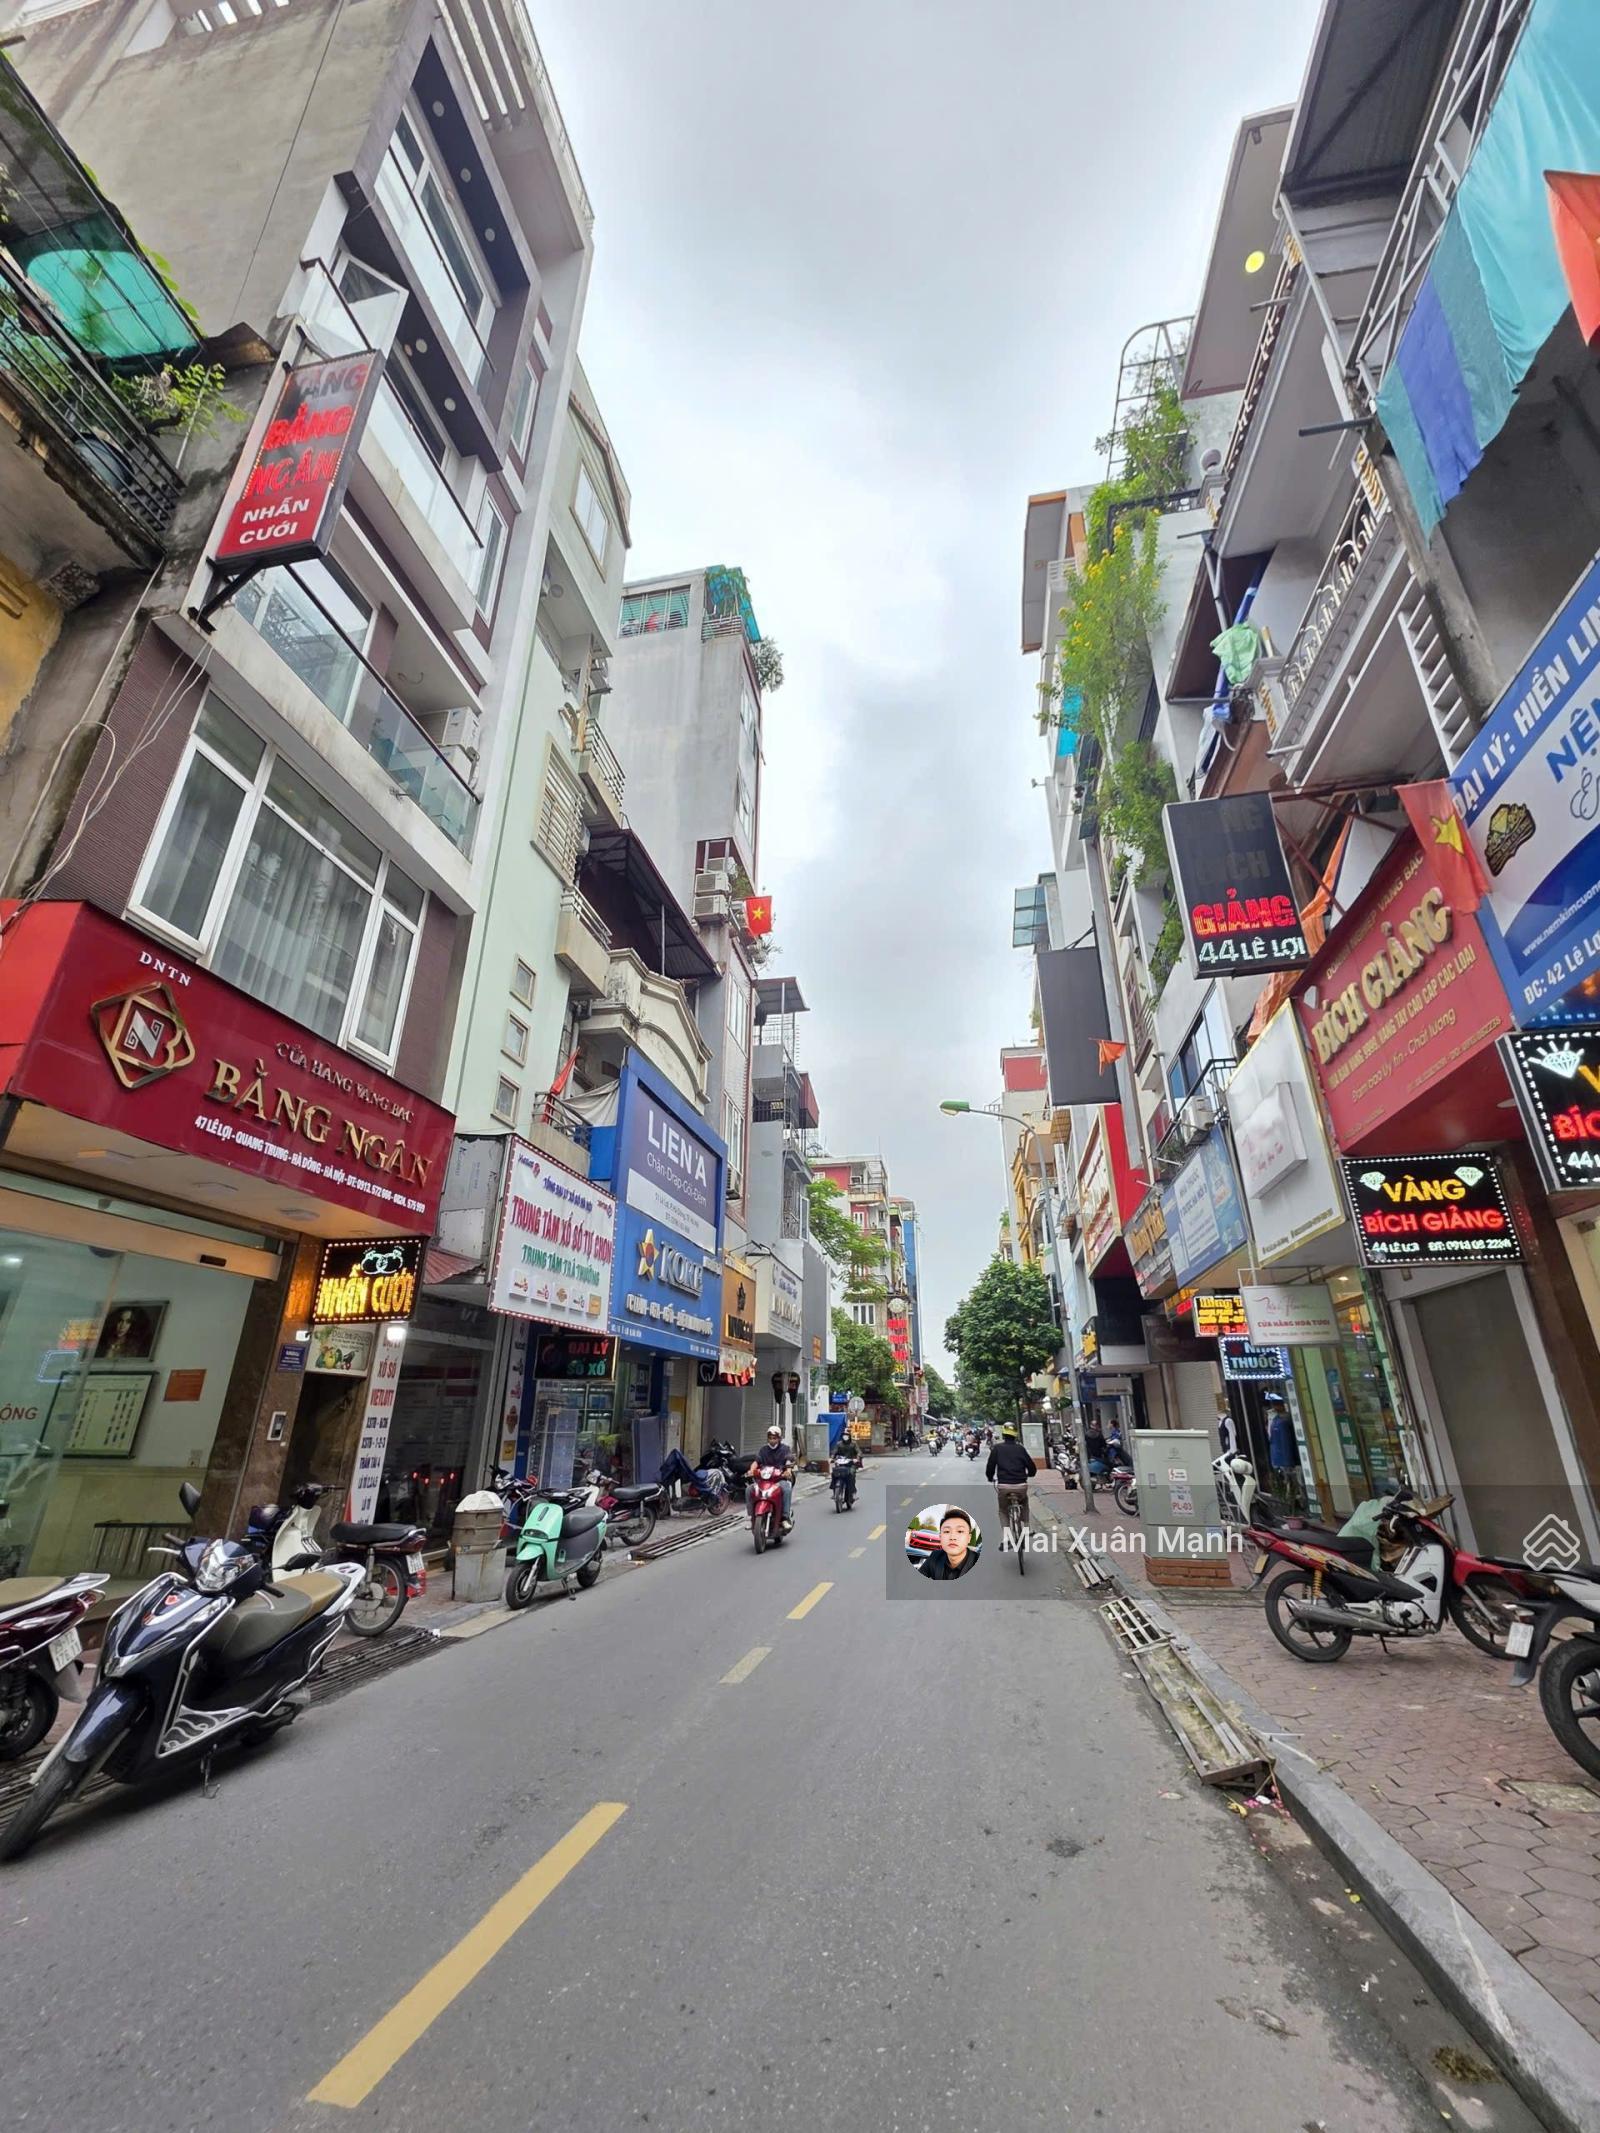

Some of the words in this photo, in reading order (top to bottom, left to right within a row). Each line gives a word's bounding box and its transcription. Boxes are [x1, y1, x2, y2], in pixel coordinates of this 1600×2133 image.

[239, 521, 298, 545] CƯỚI
[1482, 733, 1516, 781] LÝ:
[1513, 654, 1571, 738] HIỀN
[1192, 887, 1297, 938] GIẢNG
[1199, 939, 1239, 964] 44
[1271, 936, 1306, 961] LỢI
[1454, 943, 1477, 974] LOẠI
[139, 950, 192, 987] DNTN
[1311, 982, 1369, 1065] BÍCH
[1361, 886, 1453, 1010] GIẢNG
[1523, 978, 1548, 1005] ĐC:
[1547, 962, 1566, 986] 42
[1564, 945, 1585, 973] Lê
[194, 1115, 208, 1132] 47
[206, 1116, 219, 1137] LÊ
[217, 1122, 231, 1143] LỢI
[235, 1130, 265, 1152] QUANG
[264, 1140, 288, 1163] TRUNG
[336, 1119, 433, 1189] NGÂN
[1567, 1150, 1593, 1169] 44
[1382, 1174, 1467, 1203] VÀNG
[510, 1194, 542, 1235] TRUNG
[1363, 1208, 1419, 1234] BÍCH
[1421, 1204, 1506, 1232] GIẢNG
[521, 1244, 547, 1269] TRUNG
[1371, 1241, 1388, 1254] 44
[593, 1337, 610, 1355] LÝ
[1230, 1351, 1279, 1369] THUỐC
